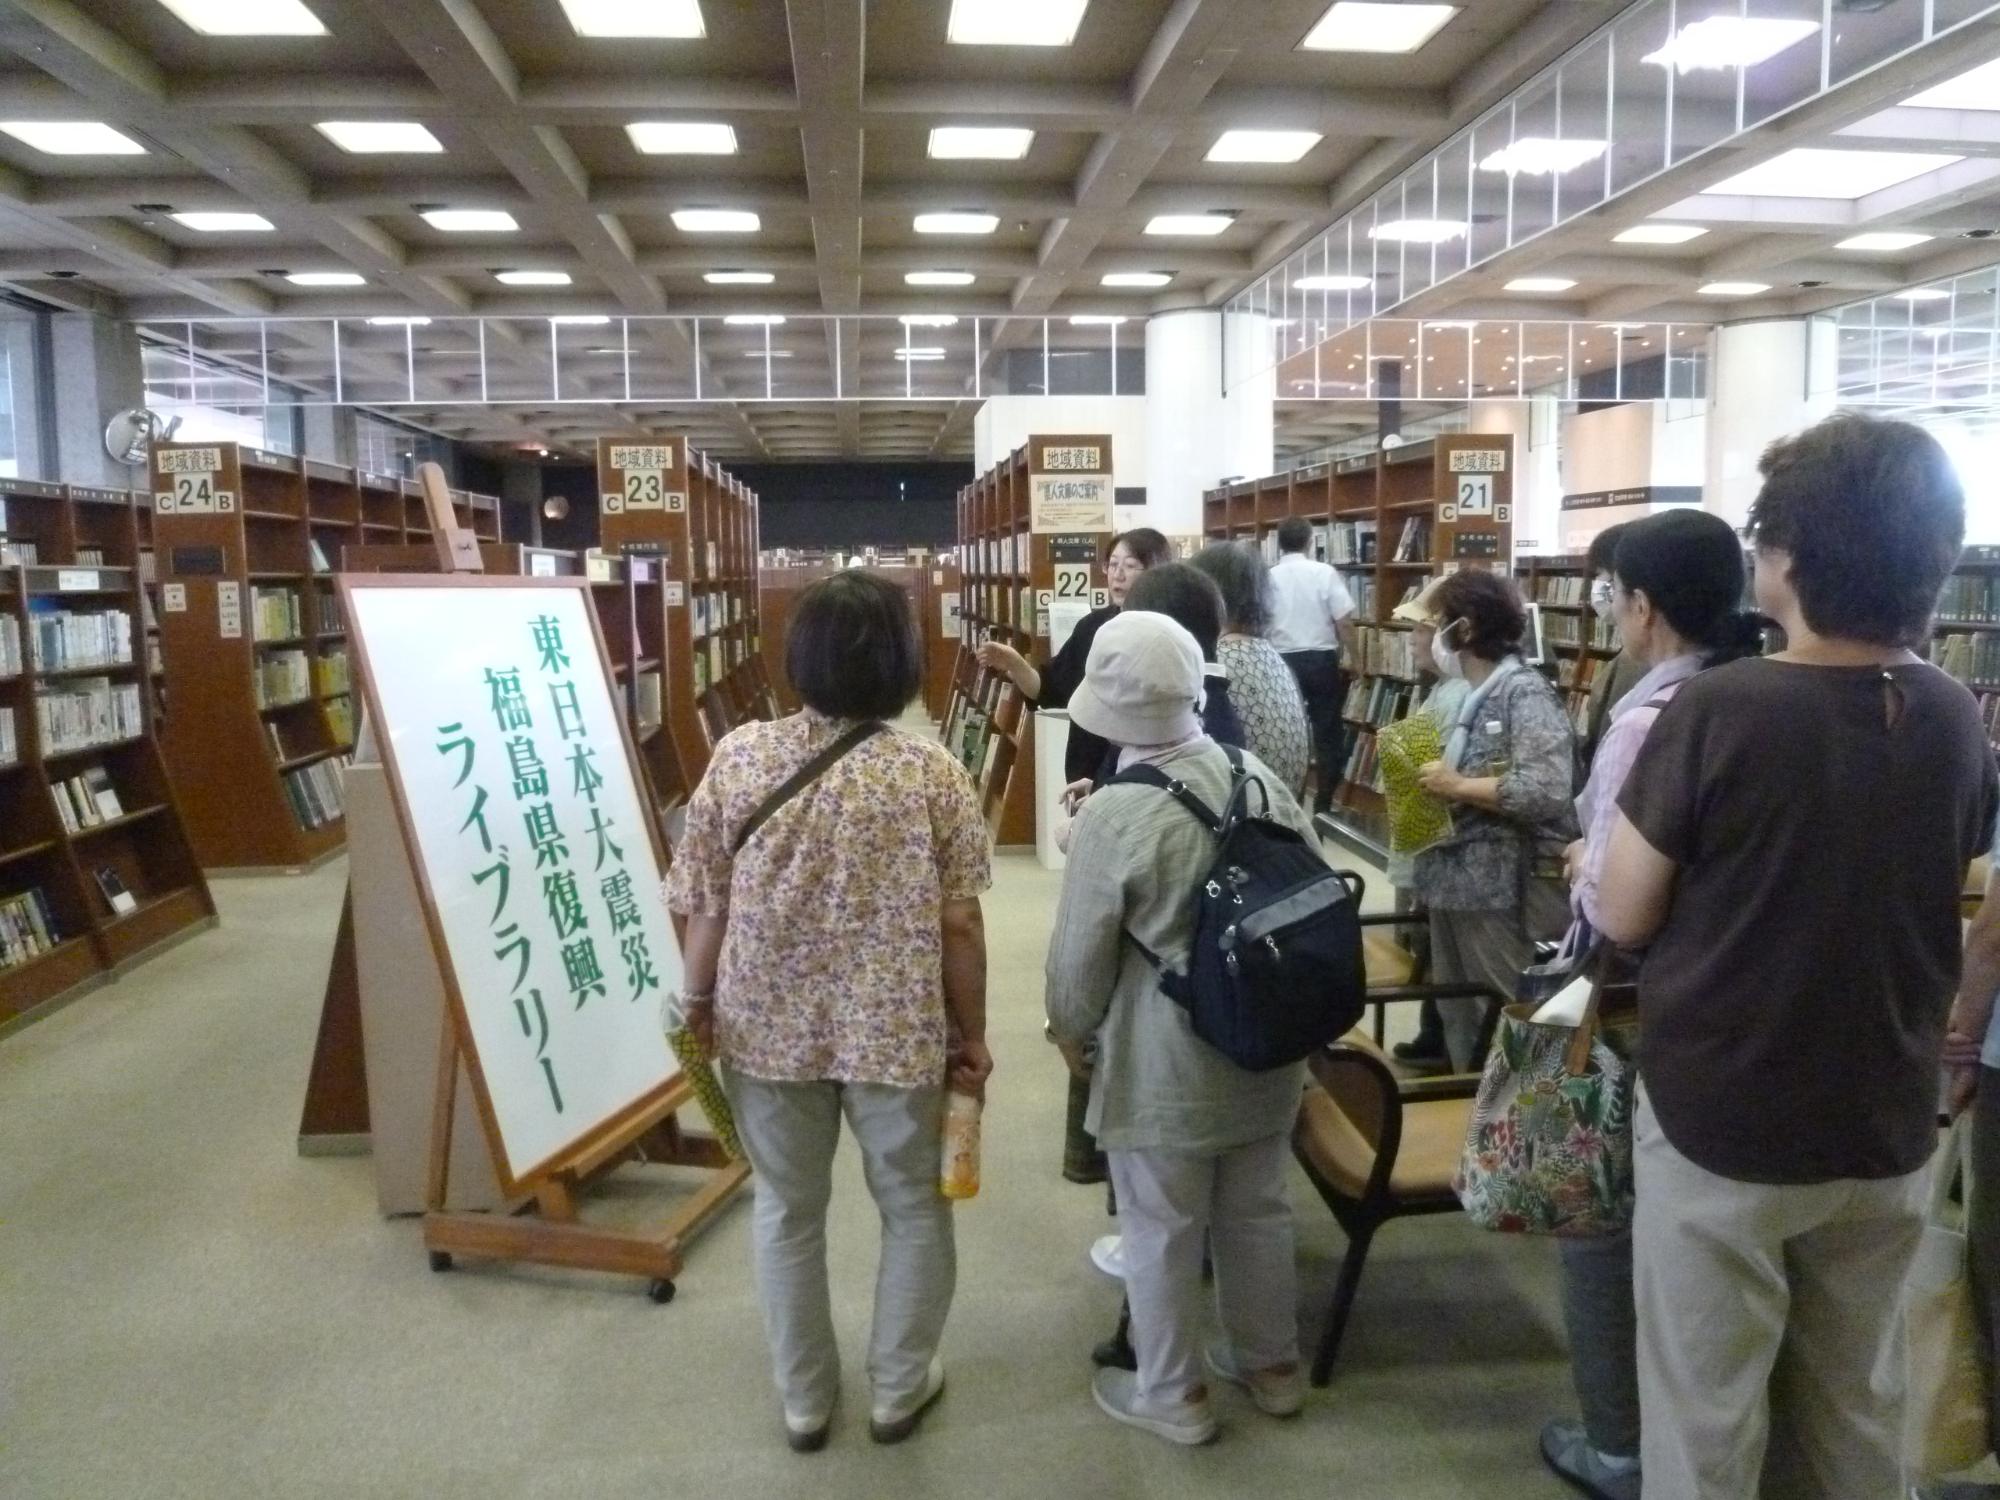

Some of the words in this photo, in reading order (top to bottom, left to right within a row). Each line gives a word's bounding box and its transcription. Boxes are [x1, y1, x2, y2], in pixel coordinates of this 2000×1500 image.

[161, 449, 217, 472] 地域資料
[614, 447, 668, 469] 地域資料
[1047, 448, 1098, 469] 地域資料
[1453, 451, 1501, 471] 地域資料
[160, 496, 172, 511] C
[179, 478, 211, 506] 24
[219, 495, 231, 510] B
[606, 496, 620, 512] C
[627, 475, 660, 503] 23
[669, 495, 681, 510] B
[1442, 505, 1454, 520] C
[1460, 482, 1487, 508] 21
[1498, 506, 1508, 520] B
[1039, 592, 1051, 607] C
[1057, 571, 1088, 598] 22
[1095, 591, 1106, 606] B
[528, 613, 659, 1003] 東日本大震災
[483, 665, 606, 1012] 福島県復興
[436, 721, 564, 1114] ライブラリー
